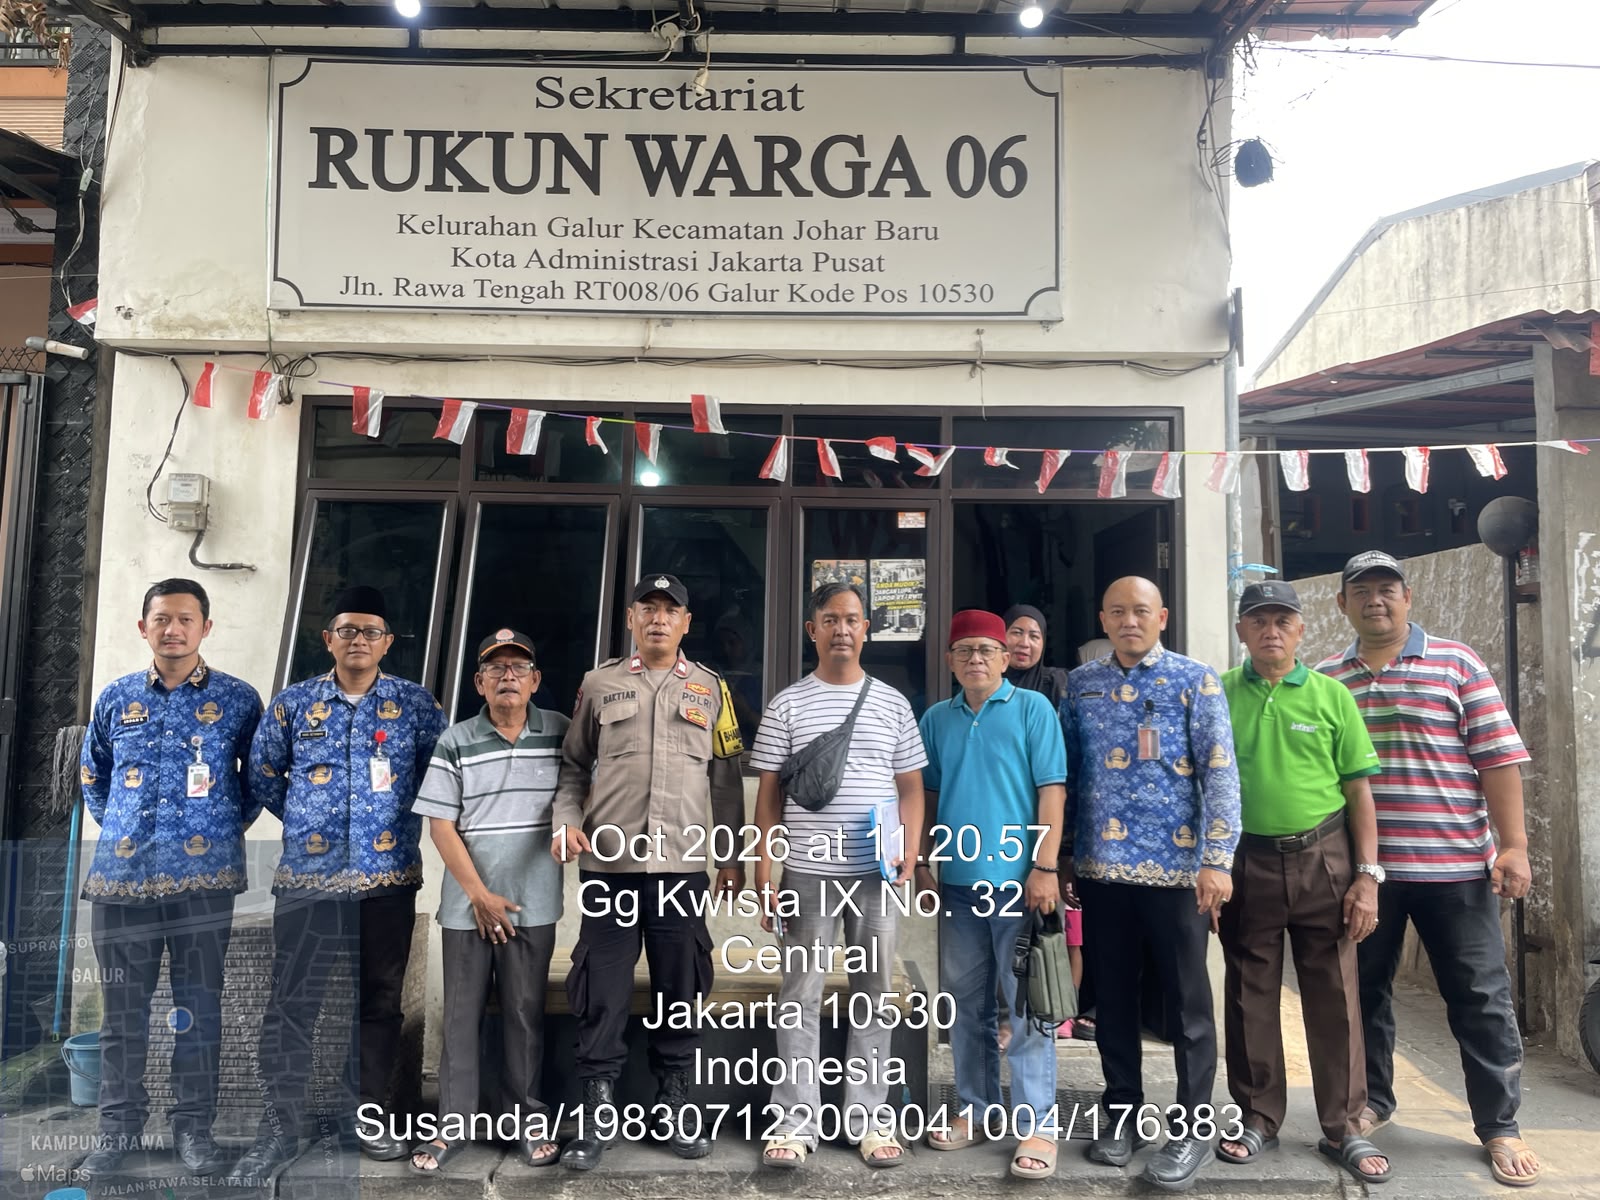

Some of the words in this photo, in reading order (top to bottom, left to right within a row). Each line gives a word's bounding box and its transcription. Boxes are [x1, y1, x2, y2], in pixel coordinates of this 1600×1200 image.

[535, 76, 805, 112] Sekretariat
[308, 127, 608, 195] RUKUN
[625, 134, 931, 198] WARGA
[946, 134, 1028, 199] 06
[396, 213, 537, 237] Kelurahan
[547, 216, 624, 239] Galur
[633, 218, 784, 240] Kecamatan
[793, 219, 866, 241] Johar
[874, 220, 939, 241] Baru
[450, 247, 517, 269] Kota
[524, 248, 698, 272] Administrasi
[708, 251, 804, 273] Jakarta
[812, 251, 886, 273] Pusat
[339, 276, 383, 296] Jln.
[393, 277, 465, 298] Rawa
[473, 279, 564, 305] Tengah
[573, 280, 699, 302] RT008/06
[708, 282, 780, 303] Galur
[787, 283, 855, 303] Kode
[863, 284, 908, 304] Pos
[920, 284, 994, 304] 10530
[603, 690, 636, 705] BAKTIAR
[681, 691, 712, 709] POLRI
